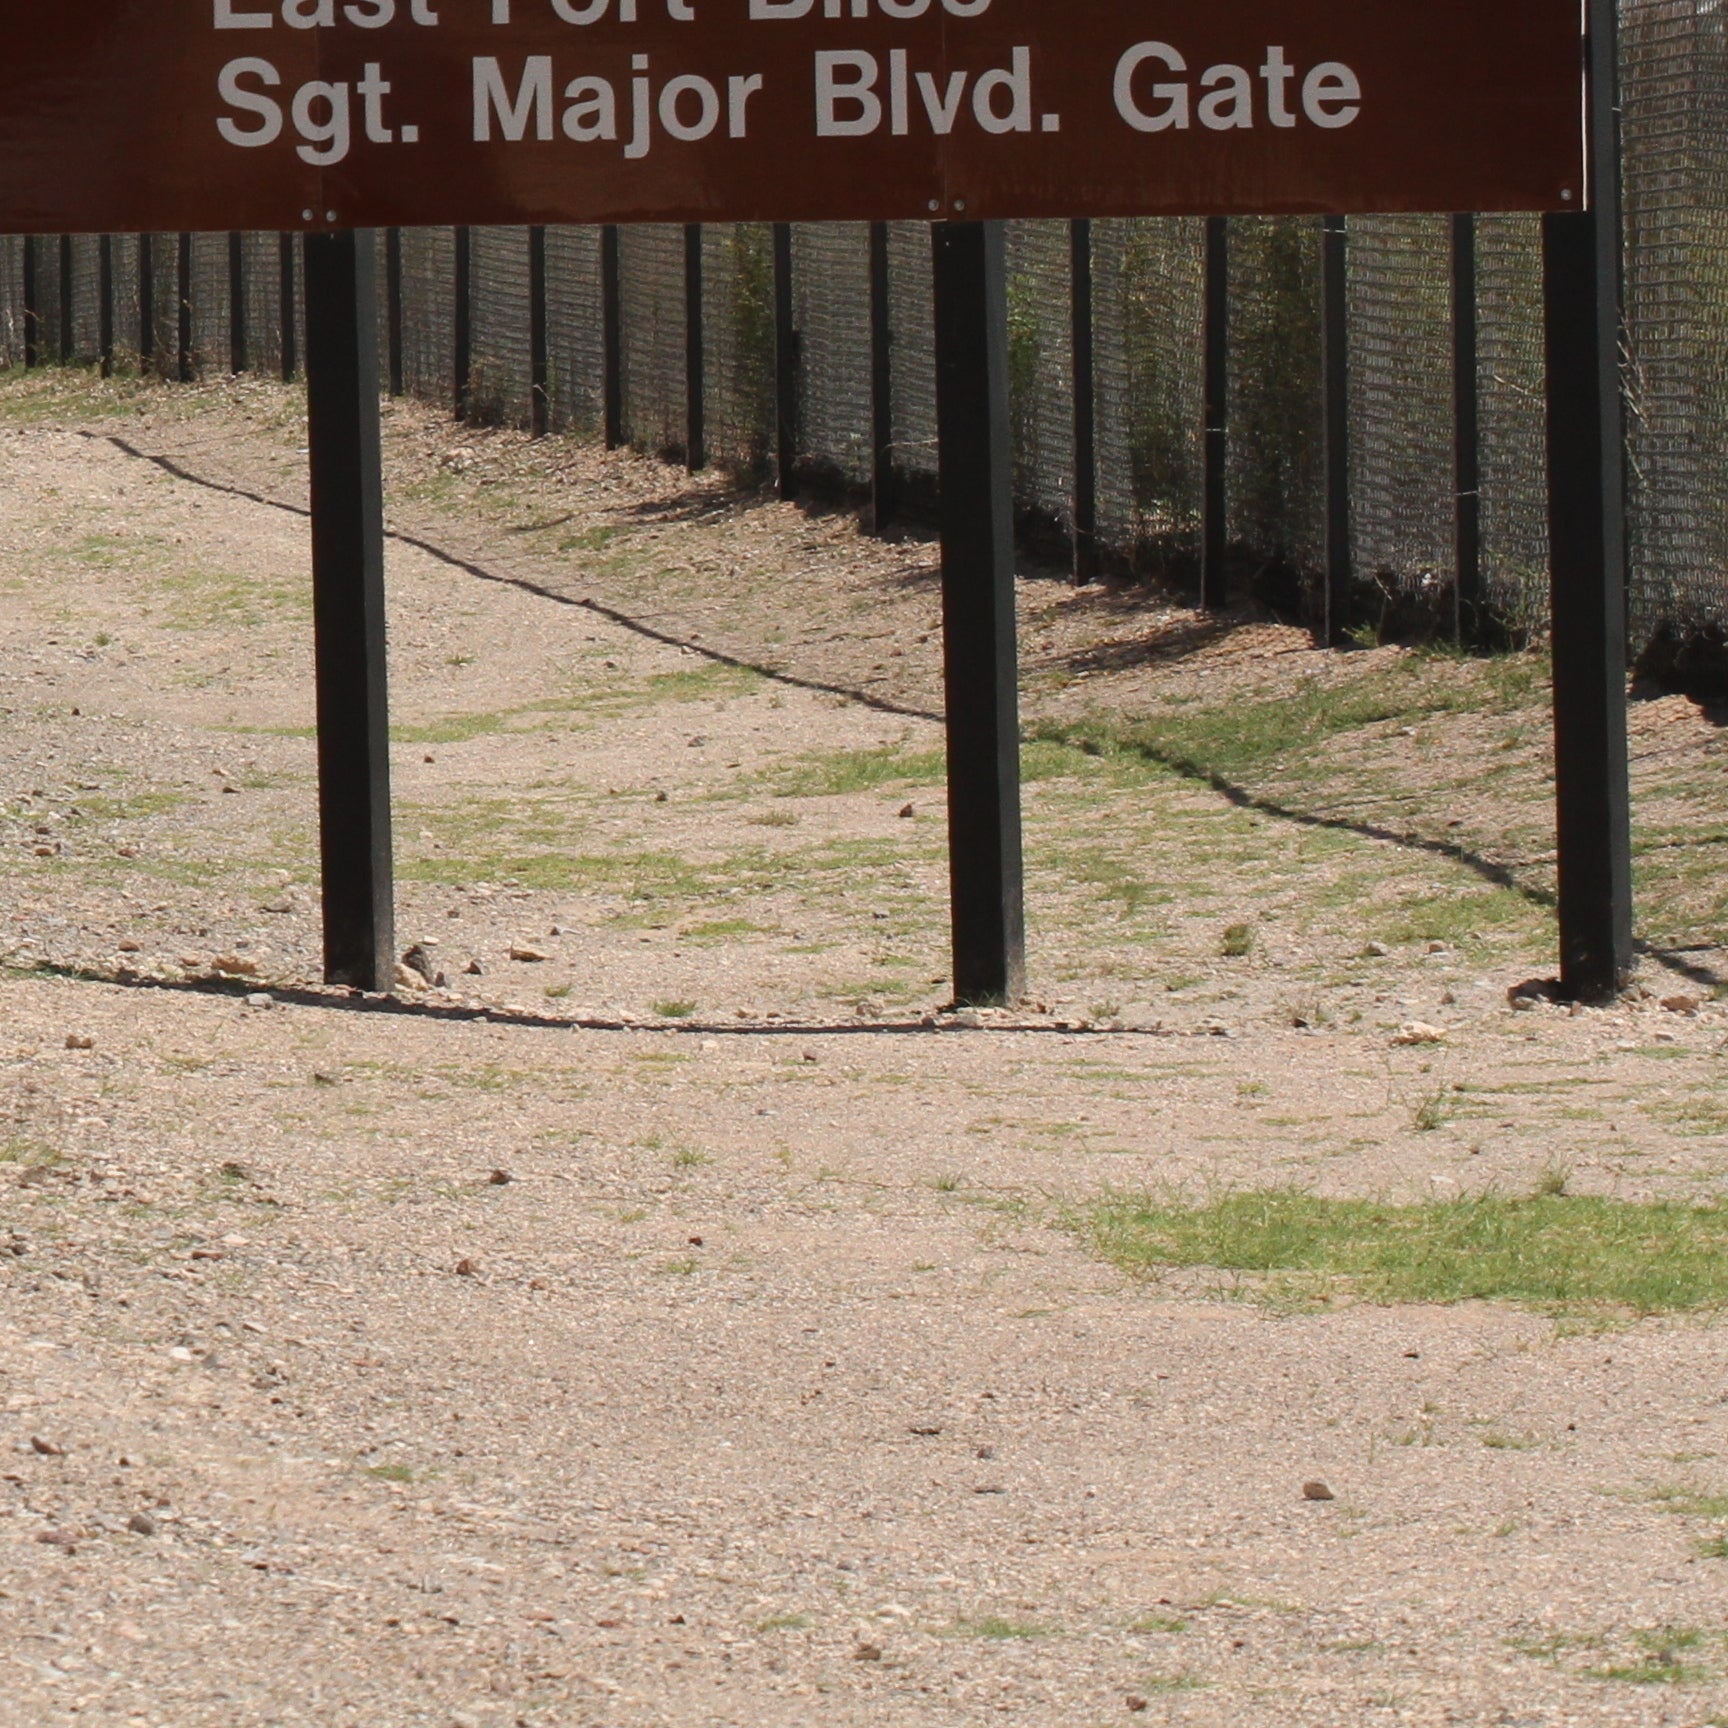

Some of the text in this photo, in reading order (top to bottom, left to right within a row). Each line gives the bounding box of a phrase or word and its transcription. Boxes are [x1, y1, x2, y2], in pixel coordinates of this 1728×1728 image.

[216, 41, 1361, 166] Sgt. Major Blvd. Gate
